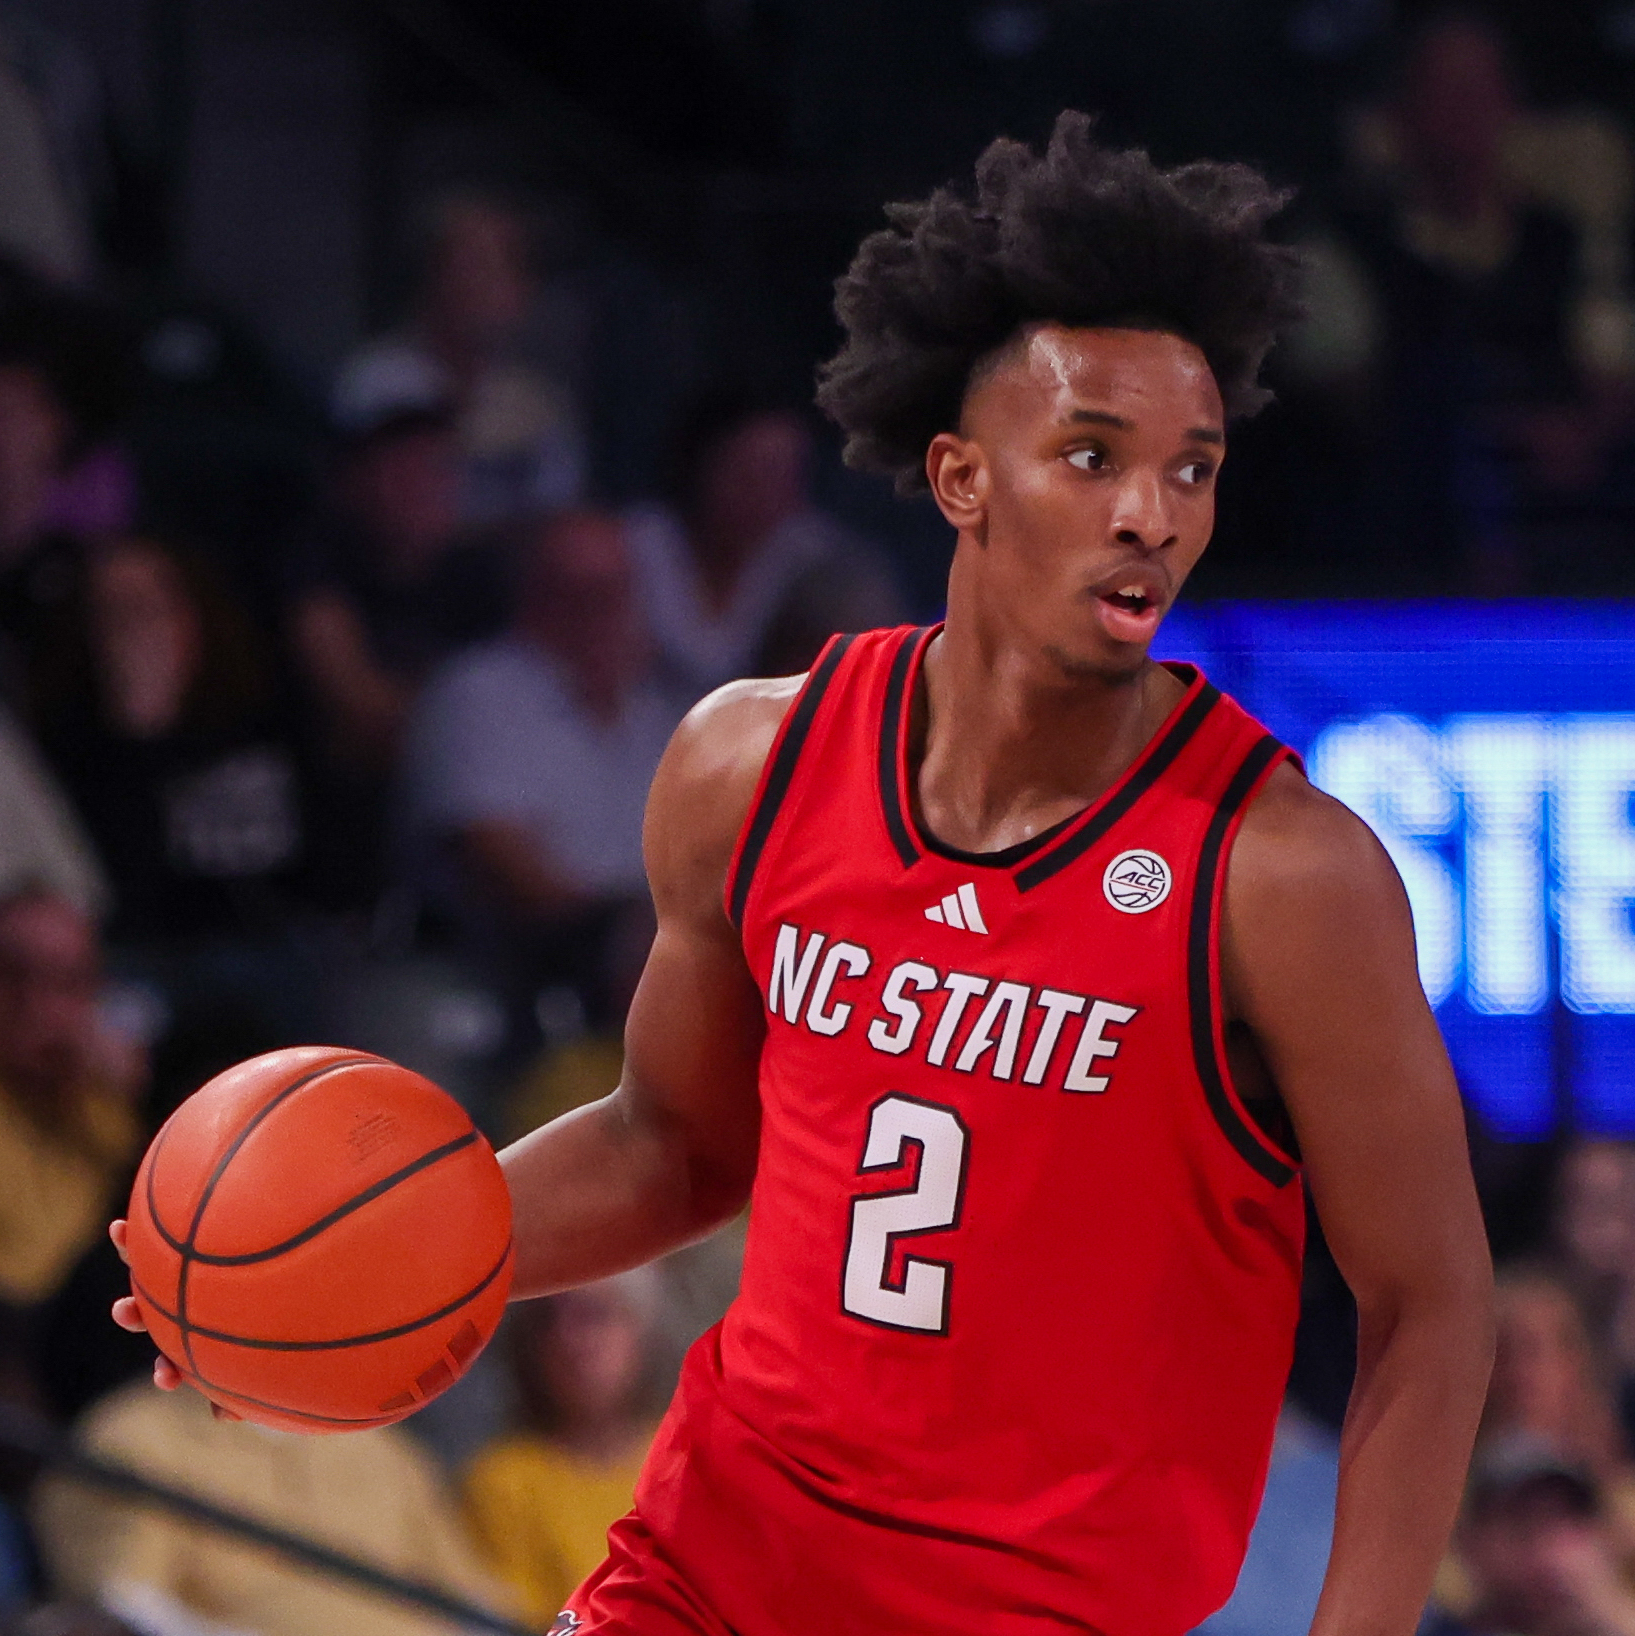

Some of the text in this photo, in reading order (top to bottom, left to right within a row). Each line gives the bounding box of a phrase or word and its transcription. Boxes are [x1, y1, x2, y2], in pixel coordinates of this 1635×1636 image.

[1116, 871, 1165, 890] ACC
[767, 923, 1141, 1094] NC STATE
[842, 1091, 969, 1337] 2
